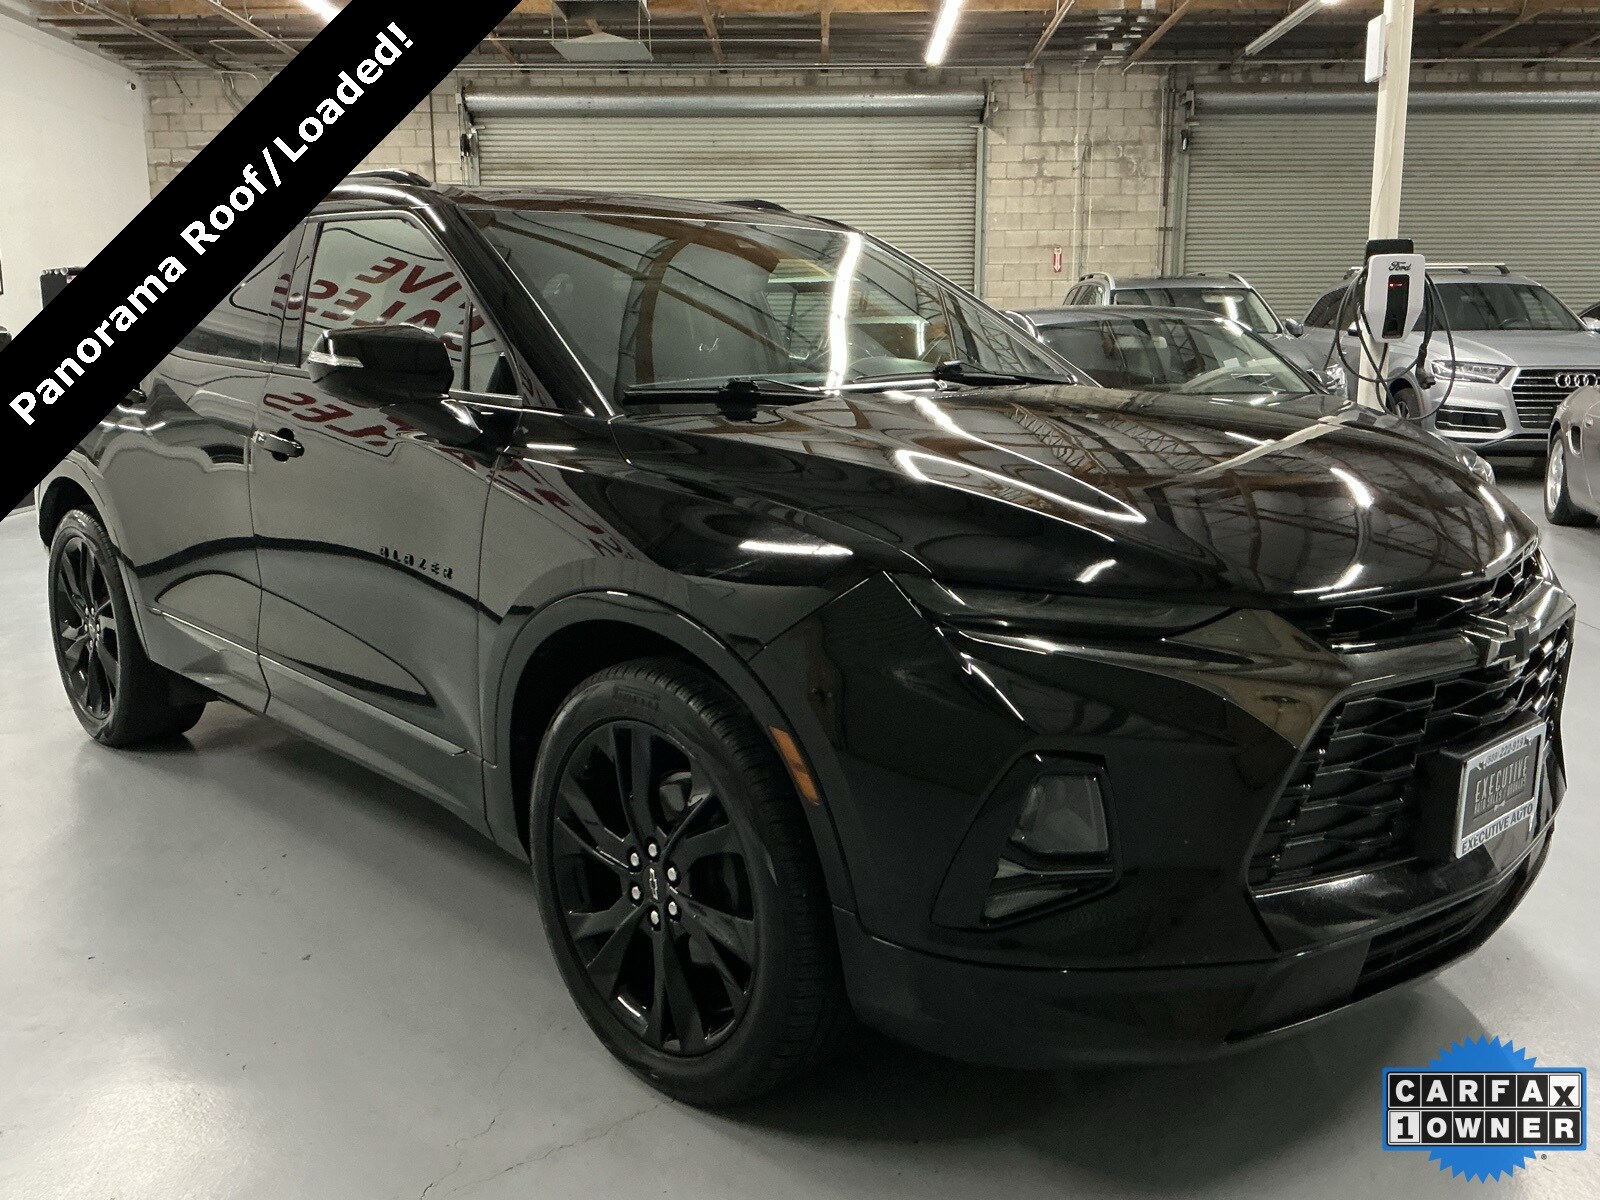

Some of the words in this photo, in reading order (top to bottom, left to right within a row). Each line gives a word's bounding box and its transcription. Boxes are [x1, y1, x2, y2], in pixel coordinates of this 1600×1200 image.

[1388, 261, 1412, 271] Ford
[380, 546, 453, 579] BLAZER
[1475, 756, 1528, 800] EXECUTIVE
[1462, 814, 1510, 853] EXECUTIVE
[1510, 803, 1534, 825] AUTO
